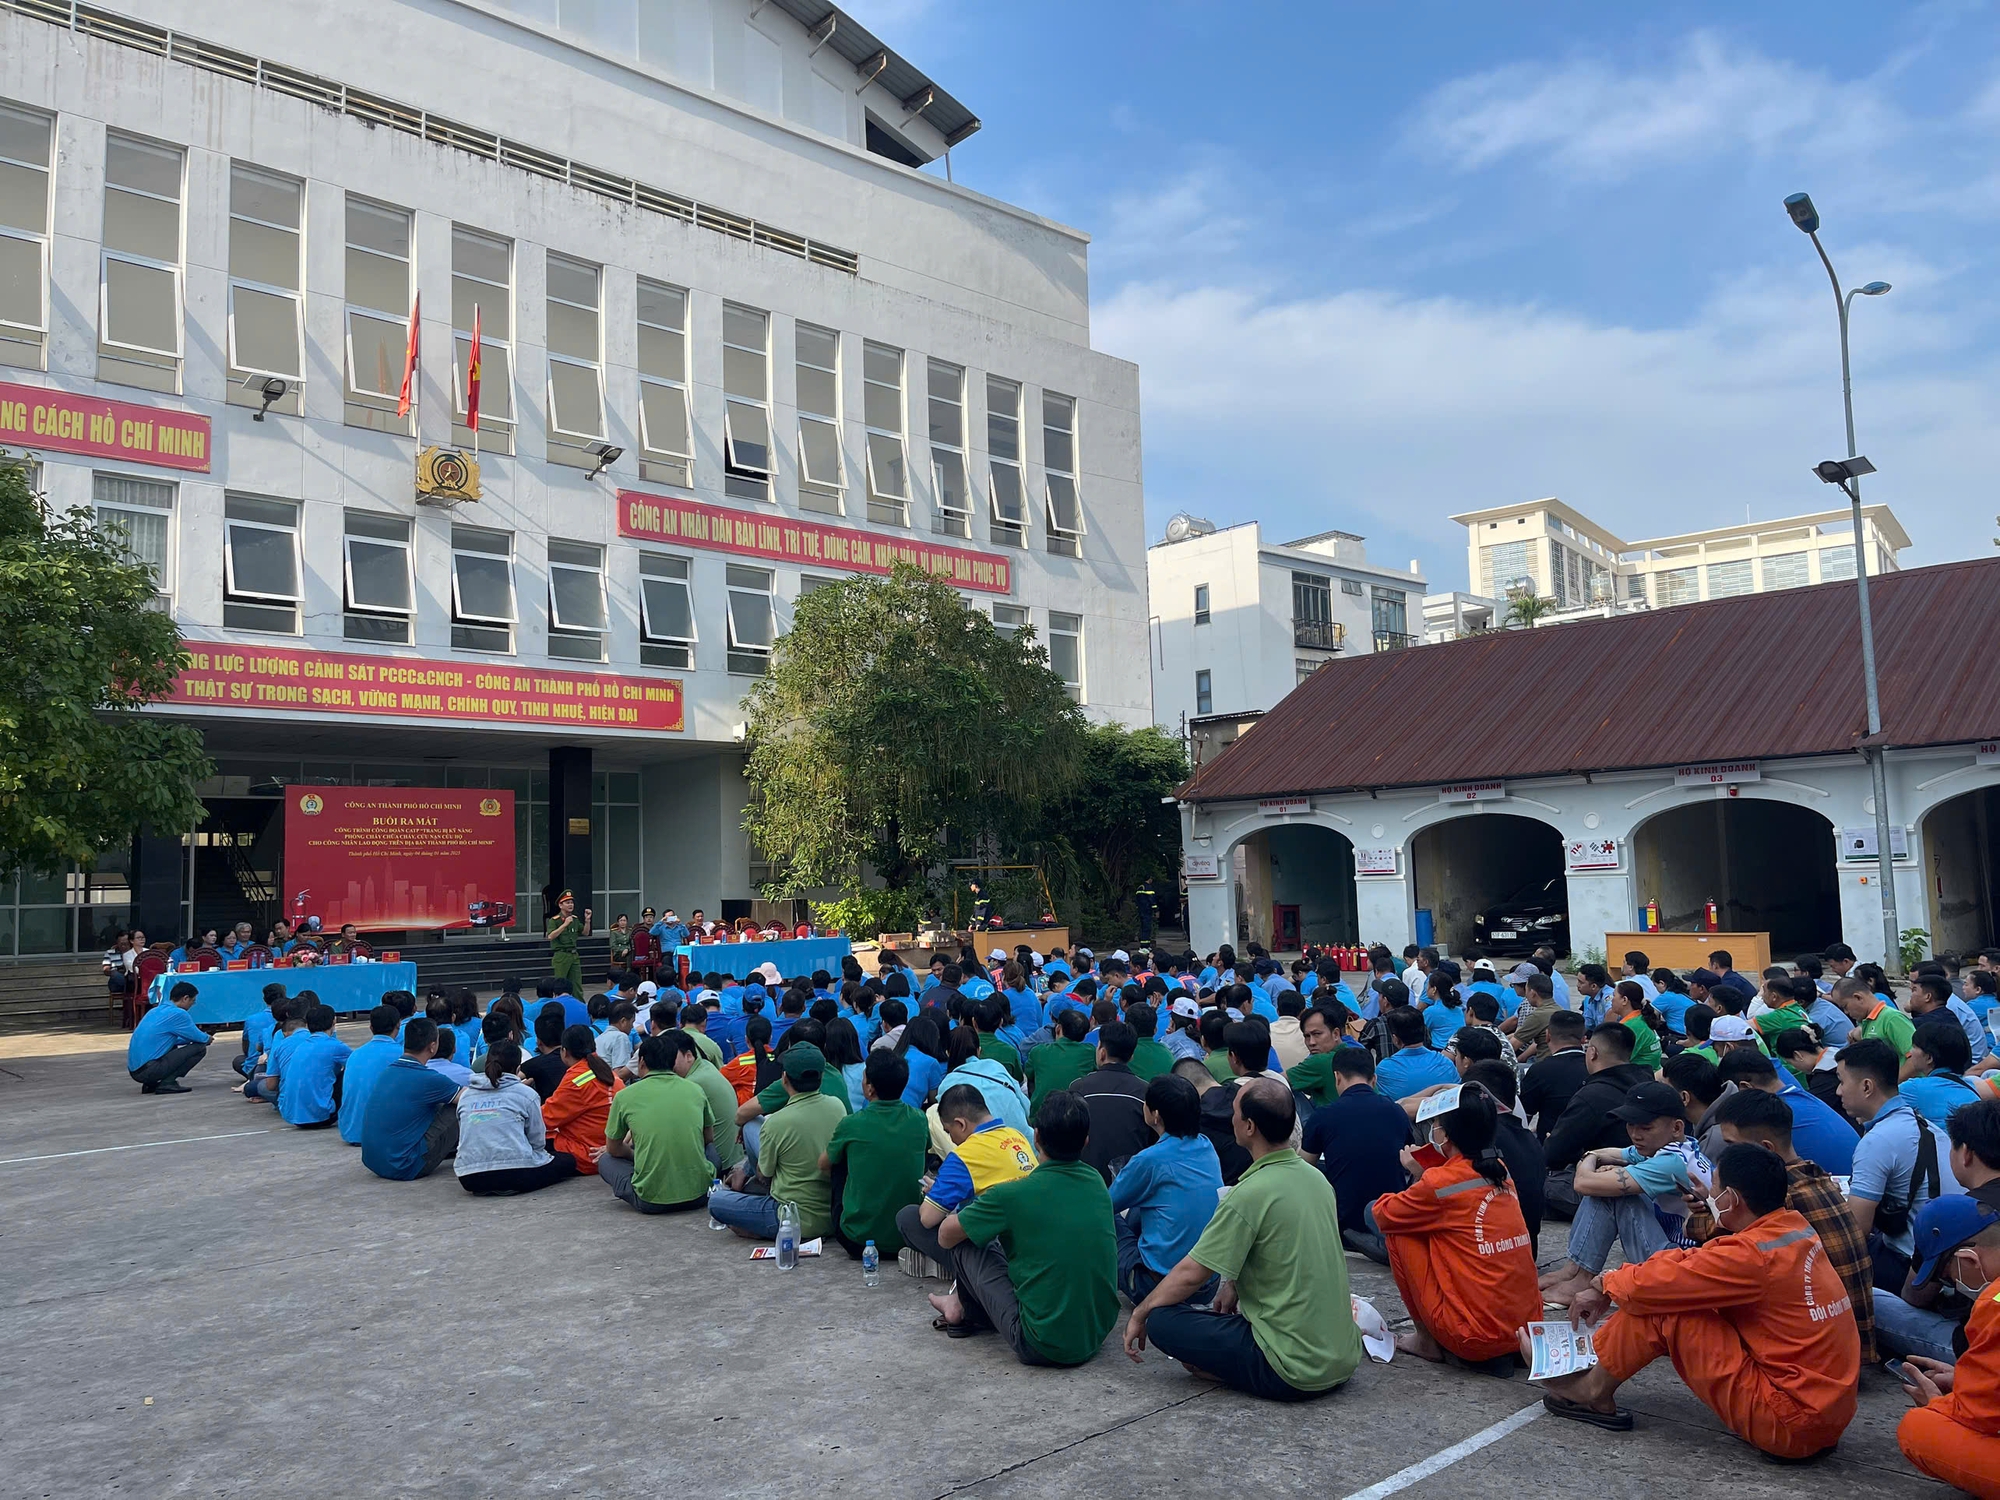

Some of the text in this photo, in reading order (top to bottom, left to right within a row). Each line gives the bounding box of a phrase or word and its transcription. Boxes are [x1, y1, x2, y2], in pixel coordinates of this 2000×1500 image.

[32, 403, 84, 441] CÁCH
[89, 407, 116, 446] HỒ
[121, 419, 154, 452] CHÍ
[158, 425, 206, 460] MINH
[629, 499, 661, 533] CÔNG
[663, 508, 678, 536] AN
[680, 510, 709, 541] NHÂN
[711, 513, 733, 545] DÂN
[735, 515, 756, 548] BẢN
[783, 526, 801, 555] TRÍ
[823, 532, 849, 563] DŨNG
[851, 535, 873, 568] CẢM,
[954, 554, 971, 582] DÂN
[972, 560, 994, 588] PHỤC
[995, 564, 1007, 591] VỤ
[214, 653, 245, 675] LỰC
[249, 657, 300, 678] LƯỢNG
[303, 658, 344, 680] CẢNH
[347, 663, 376, 682] SÁT
[379, 666, 463, 688] PCCC&CNCH
[475, 673, 511, 692] CÔNG
[513, 677, 531, 693] AN
[533, 678, 574, 696] THÀNH
[577, 679, 600, 698] PHỐ
[603, 680, 620, 699] HỒ
[622, 685, 643, 700] CHÍ
[645, 687, 675, 703] MINH
[184, 678, 638, 724] THẬT SỰ TRONG SẠCH, VỮNG MẠNH, CHÍNH QUY, TINH NHUỆ, HIỆN ĐẠI
[1980, 743, 1997, 754] HỘ
[1678, 763, 1756, 777] HỘ KINH DOANH
[1710, 774, 1723, 783] 03
[1453, 784, 1473, 793] KINH
[1474, 782, 1502, 791] DOANH
[344, 801, 366, 809] CÔNG
[400, 817, 414, 826] RA
[1478, 1240, 1495, 1257] ĐỘI
[1495, 1238, 1514, 1253] CÔNG
[1809, 1303, 1828, 1323] ĐỘI
